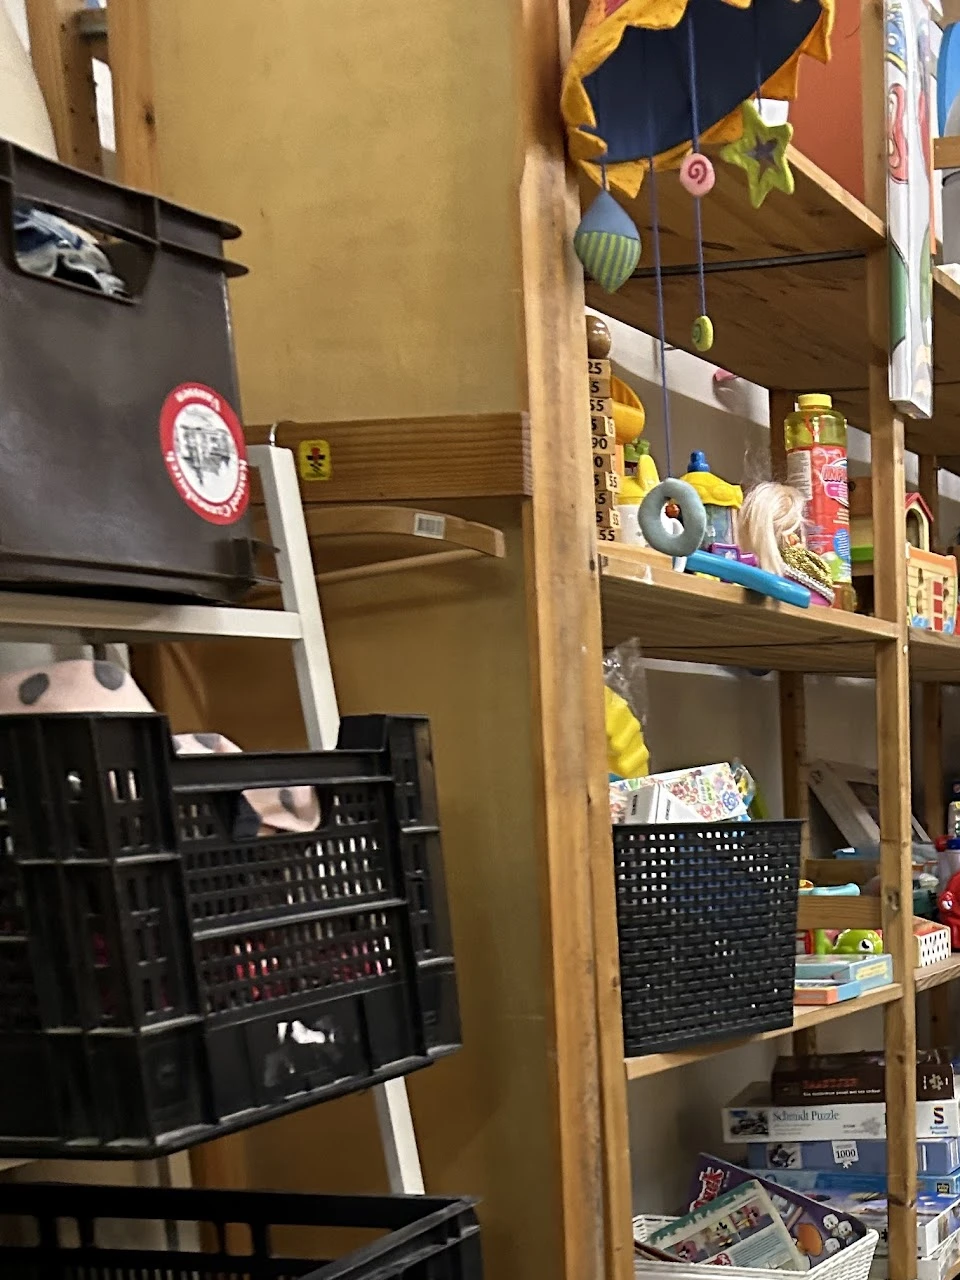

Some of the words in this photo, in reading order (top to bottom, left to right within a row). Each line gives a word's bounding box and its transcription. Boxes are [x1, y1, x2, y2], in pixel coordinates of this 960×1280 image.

[599, 529, 616, 542] 55
[772, 1108, 809, 1121] Schmidt
[811, 1109, 840, 1121] Puzzle
[933, 1107, 945, 1125] S
[835, 1148, 857, 1159] 1000
